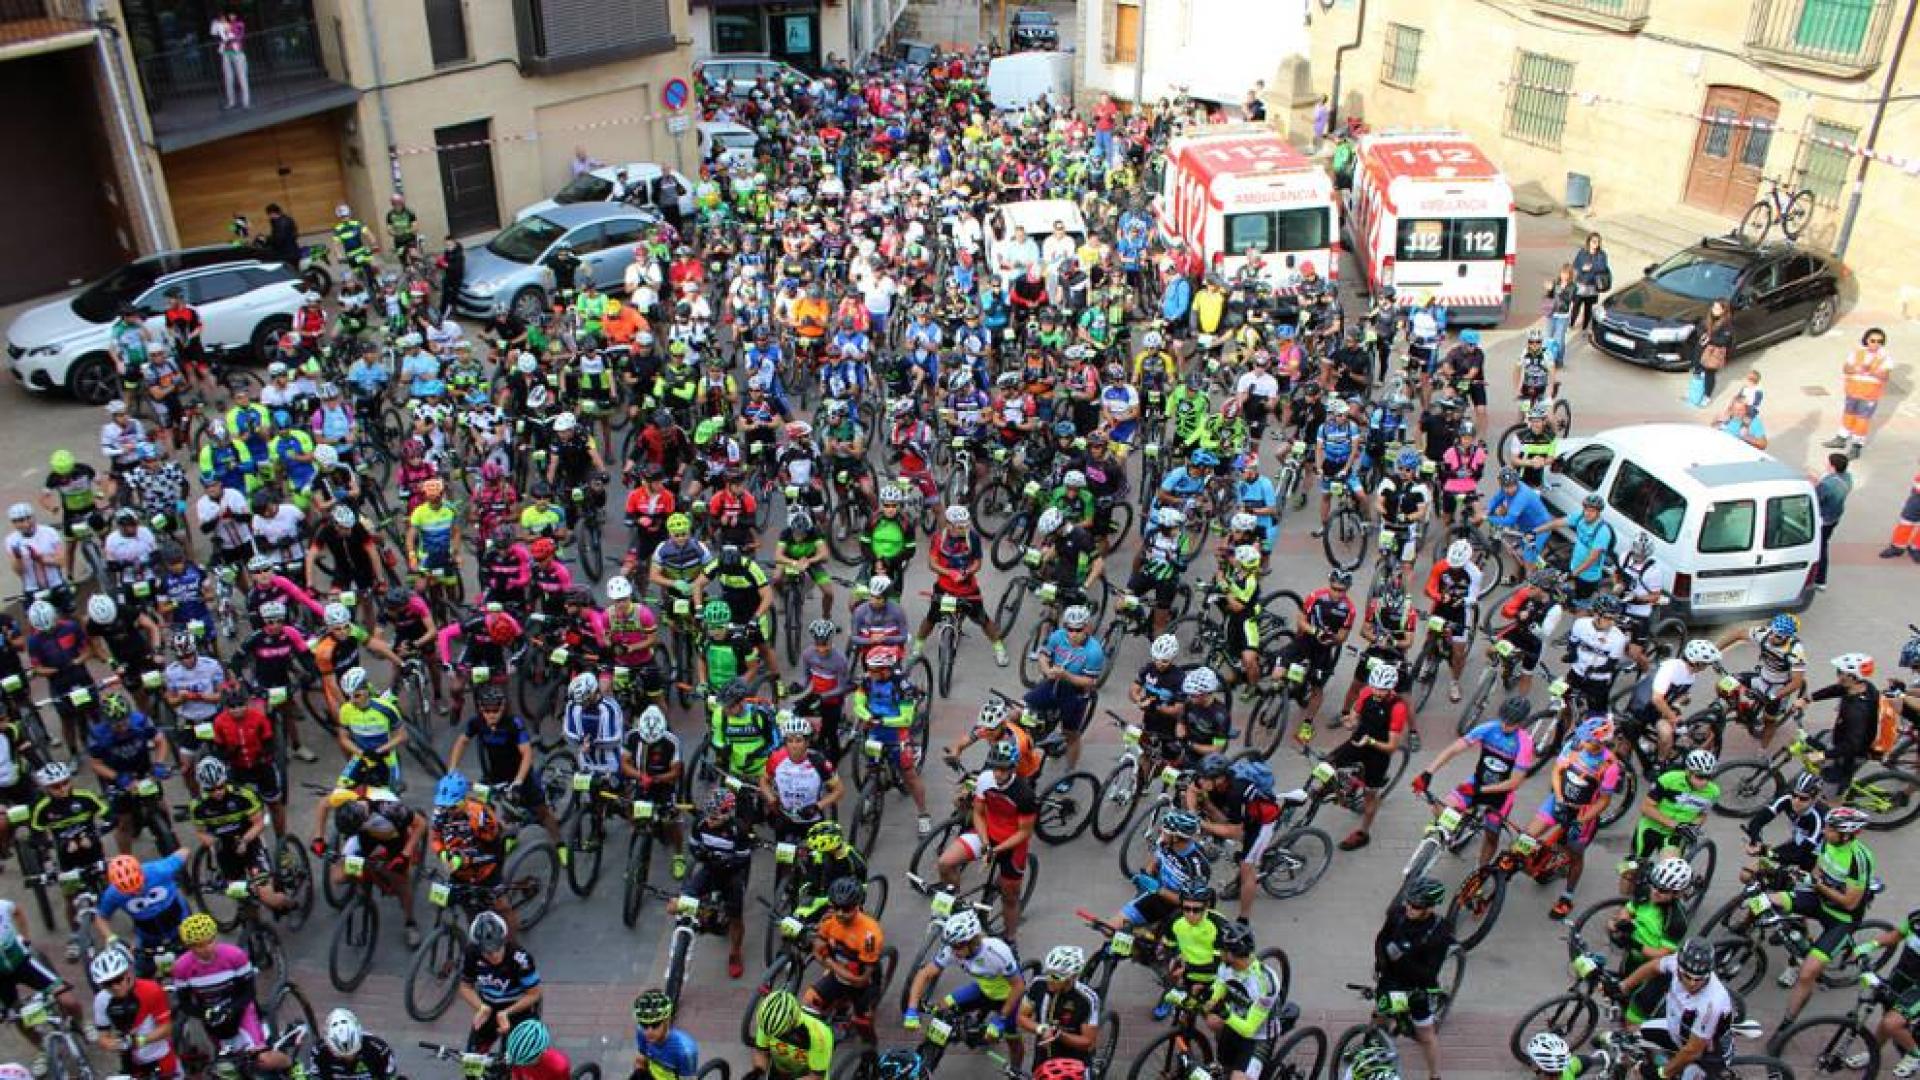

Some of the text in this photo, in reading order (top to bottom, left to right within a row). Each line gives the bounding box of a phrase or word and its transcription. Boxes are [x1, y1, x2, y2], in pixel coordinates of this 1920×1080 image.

[1203, 145, 1288, 161] 112
[1392, 149, 1478, 164] 112
[1234, 188, 1318, 204] AMBULANCIA
[1405, 232, 1442, 251] 112
[1464, 231, 1496, 253] 112
